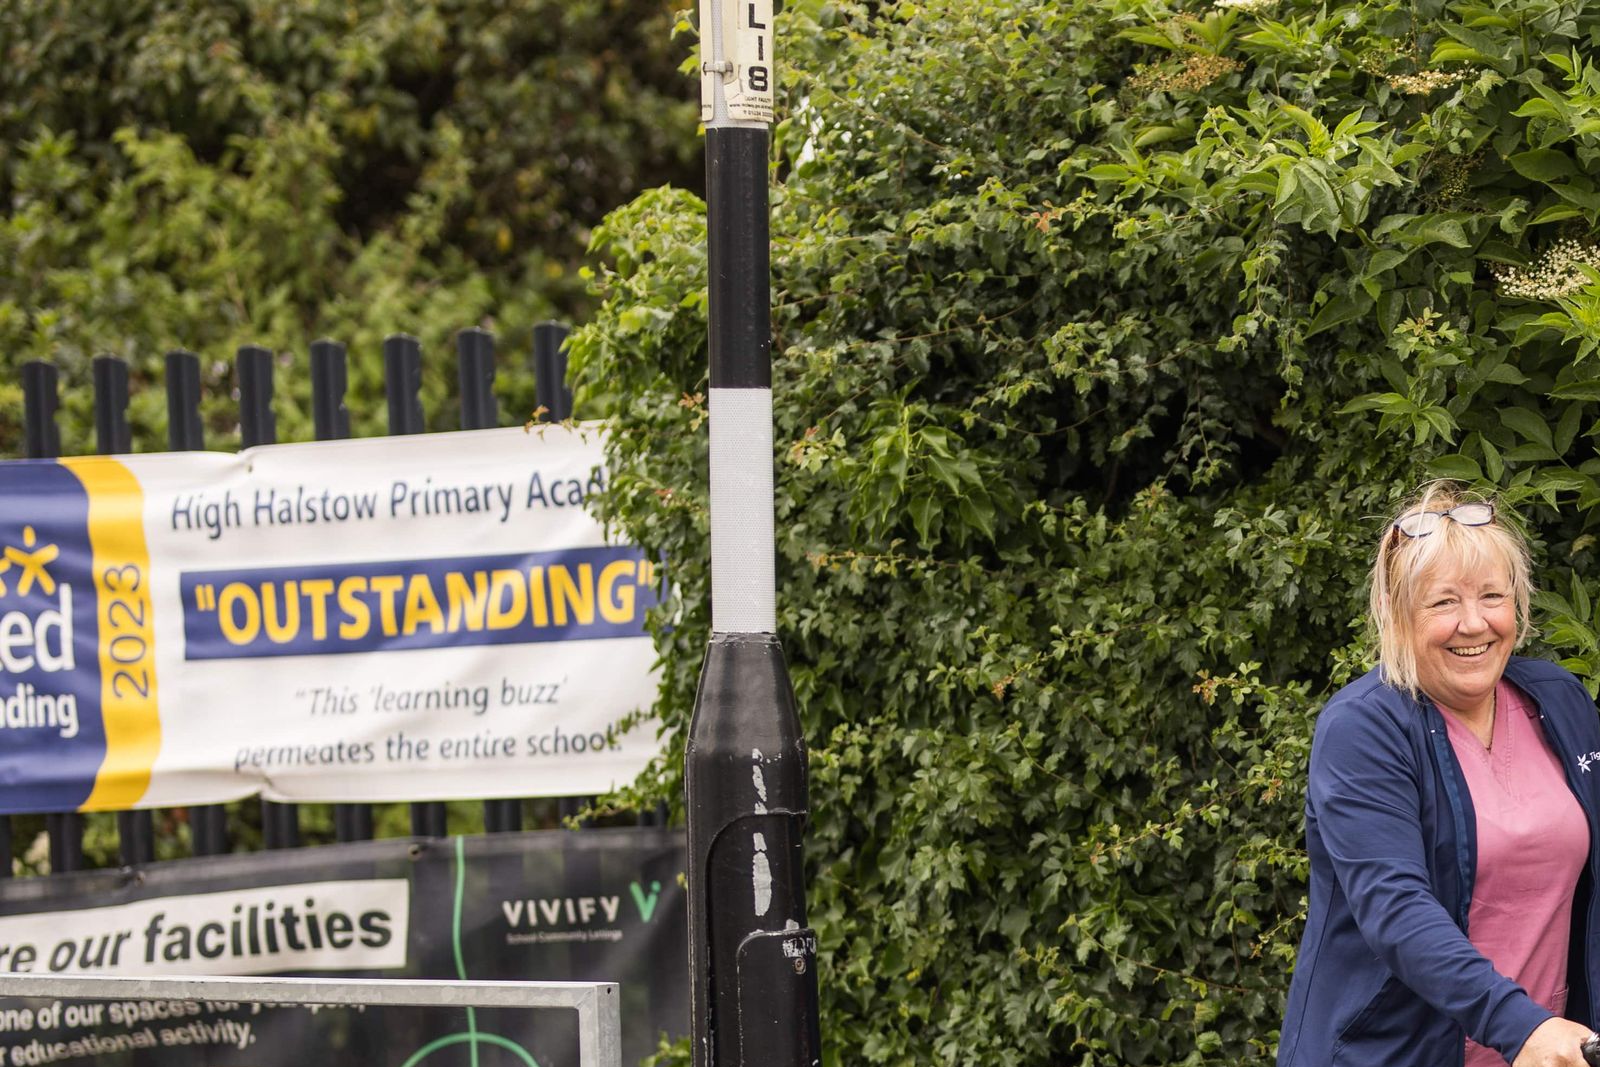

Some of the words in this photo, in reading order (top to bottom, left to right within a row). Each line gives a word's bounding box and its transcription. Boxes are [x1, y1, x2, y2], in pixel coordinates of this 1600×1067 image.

[172, 488, 241, 540] High
[254, 485, 377, 526] Halstow
[390, 476, 513, 522] Primary
[0, 583, 75, 674] ed
[103, 564, 149, 698] 2023
[195, 559, 653, 645] "OUTSTANDING"
[235, 740, 375, 773] permeates
[387, 731, 429, 762] the
[440, 729, 516, 759] entire
[49, 926, 131, 972] our
[145, 898, 392, 964] facilities
[502, 896, 620, 928] VIVIFY
[11, 1026, 157, 1067] educational
[160, 1018, 256, 1049] activity.
[37, 1000, 62, 1029] of
[64, 1003, 104, 1028] our
[108, 1000, 200, 1028] spaces
